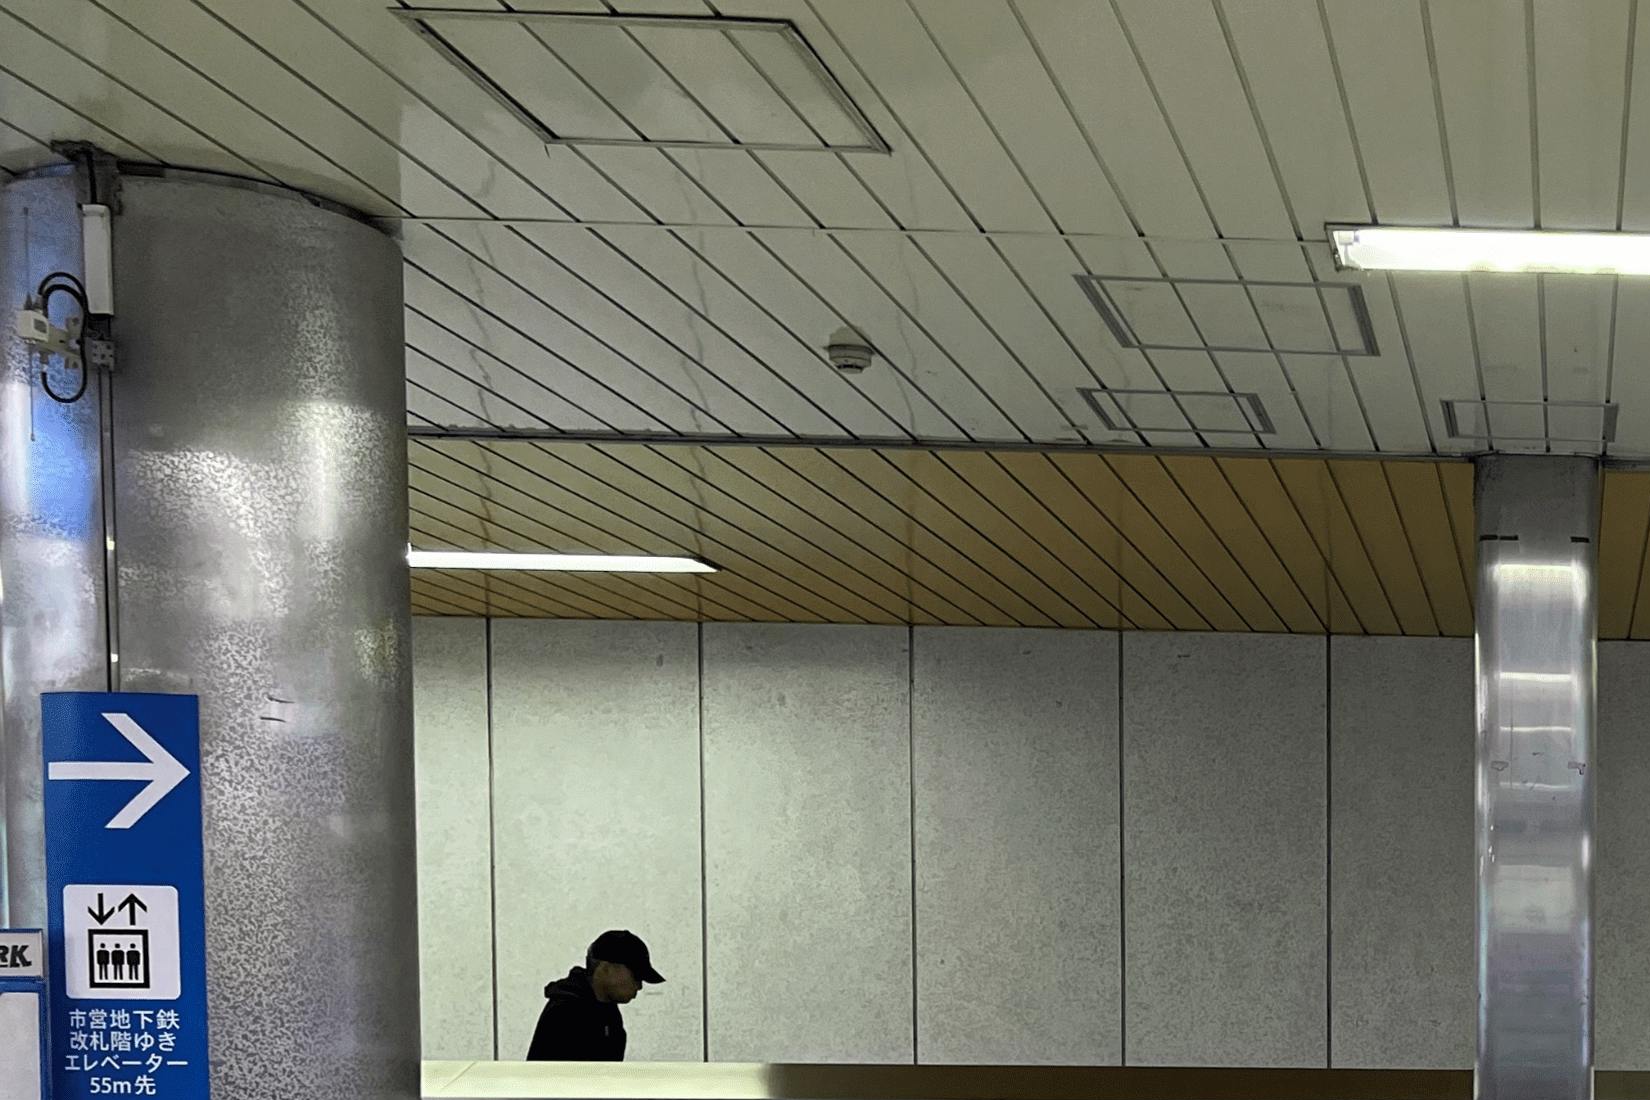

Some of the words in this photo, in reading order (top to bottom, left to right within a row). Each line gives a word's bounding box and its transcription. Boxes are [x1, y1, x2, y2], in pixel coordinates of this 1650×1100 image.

[69, 1008, 180, 1030] 市営地下鉄
[69, 1032, 177, 1051] 改札階ゆき
[65, 1054, 188, 1073] エレベーター
[90, 1075, 156, 1095] 55m先
